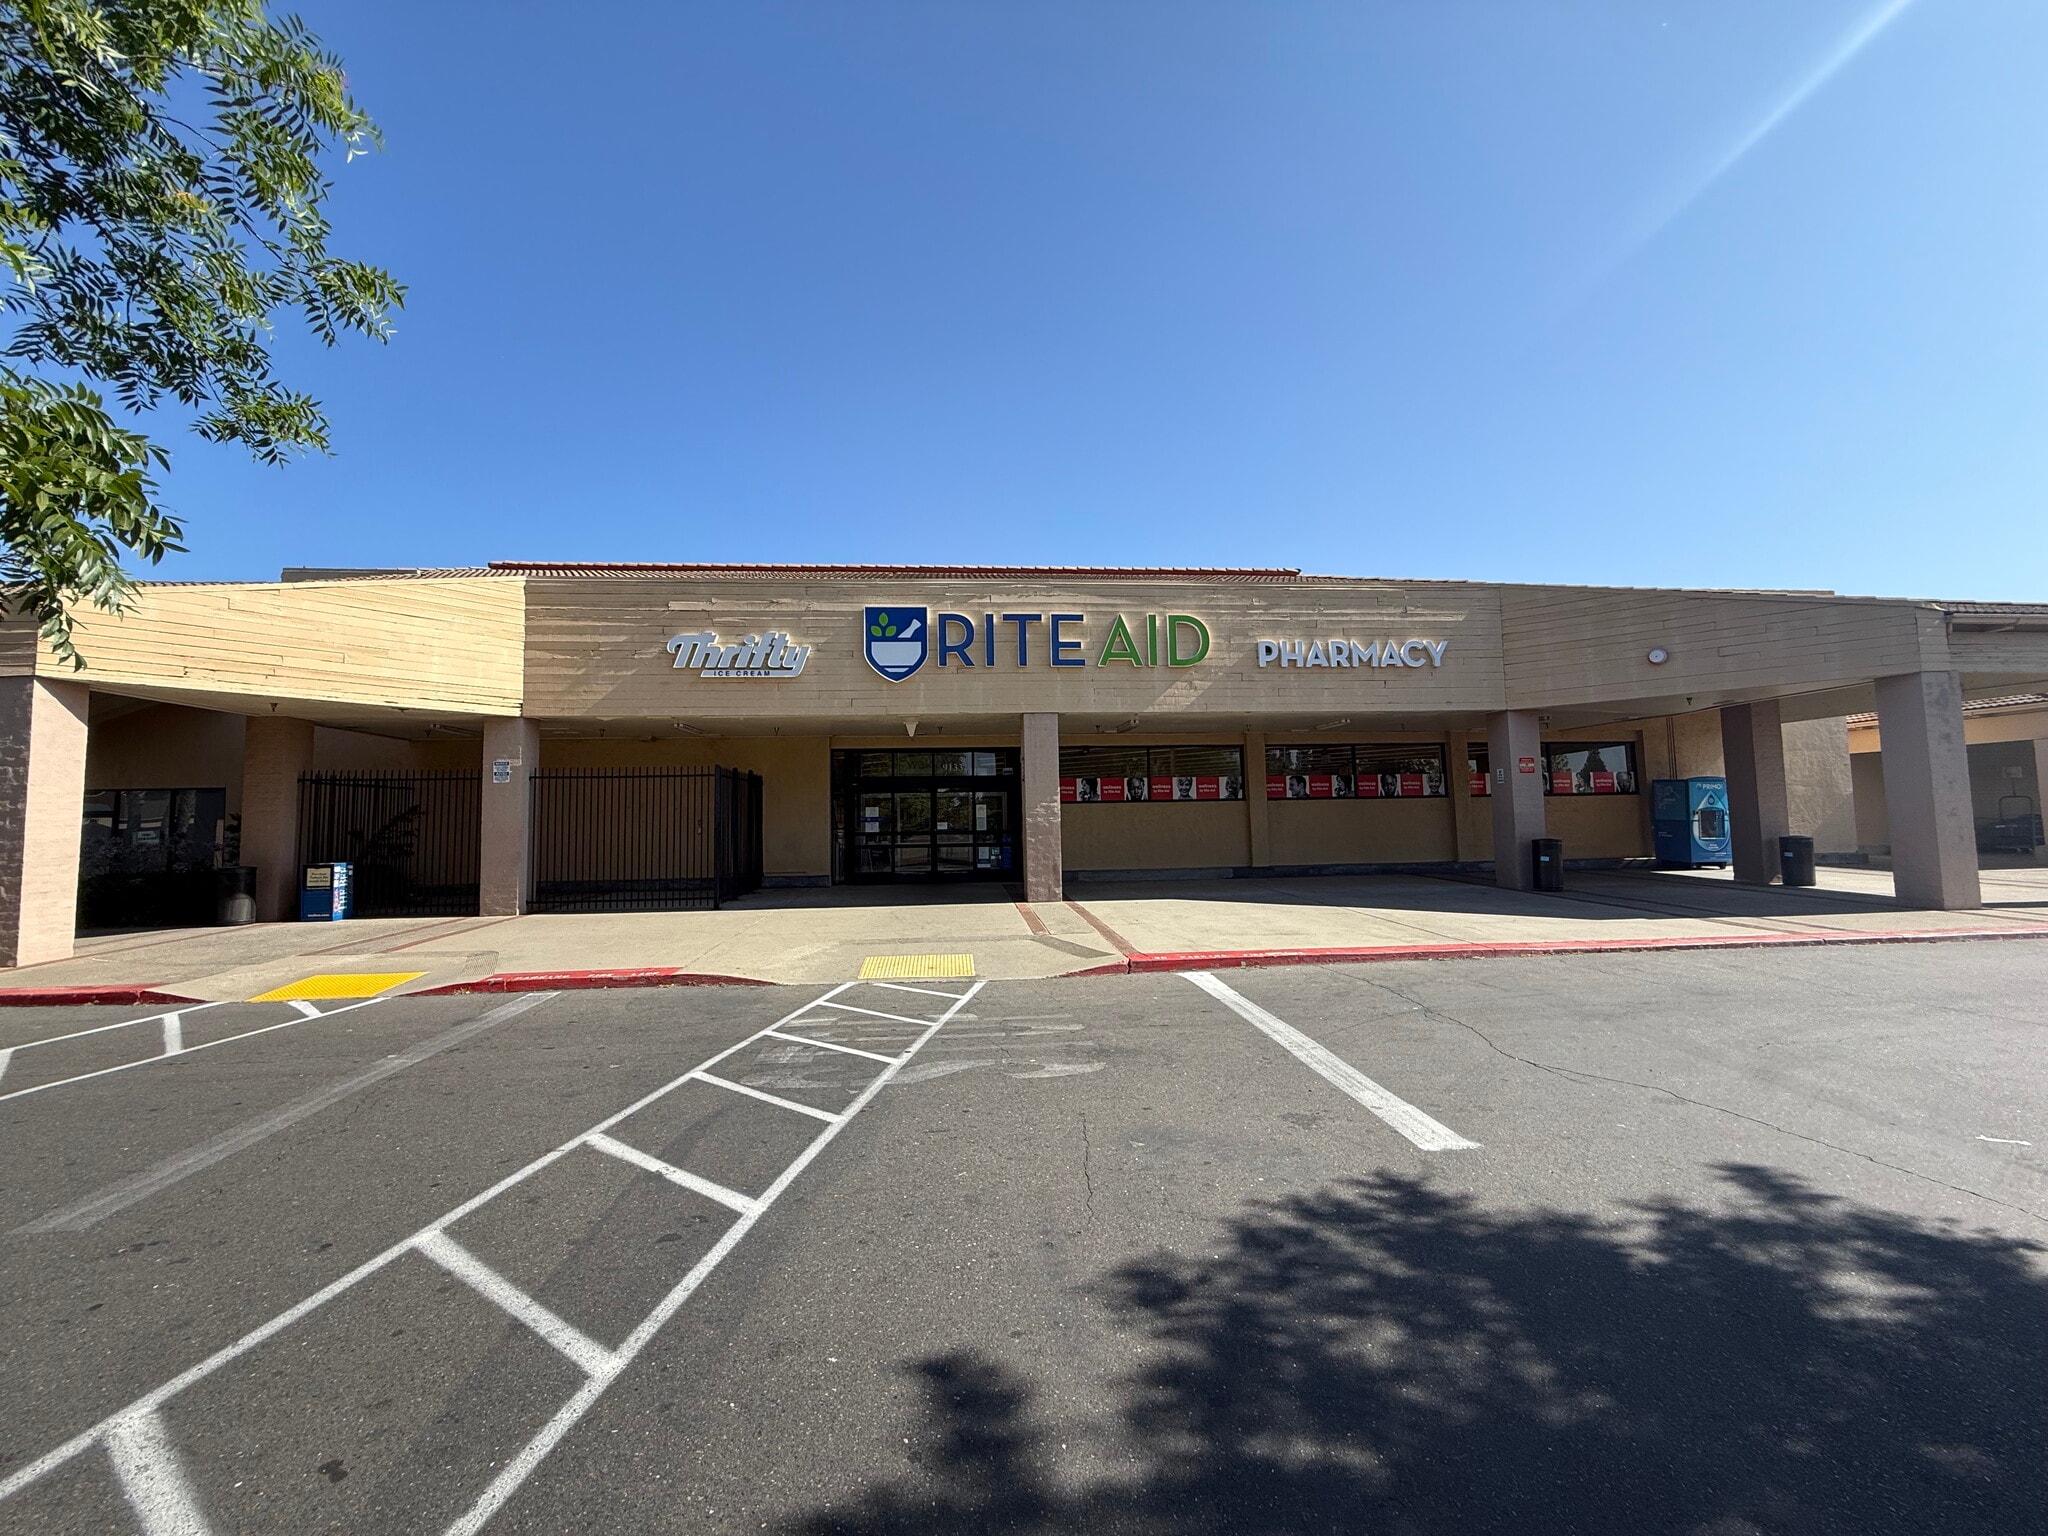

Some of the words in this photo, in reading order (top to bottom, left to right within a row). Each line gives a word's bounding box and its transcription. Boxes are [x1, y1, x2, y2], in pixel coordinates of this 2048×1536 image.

[666, 631, 811, 677] Thrifty
[937, 612, 1086, 667] RITE
[1098, 613, 1211, 667] AID
[1257, 639, 1449, 667] PHARMACY
